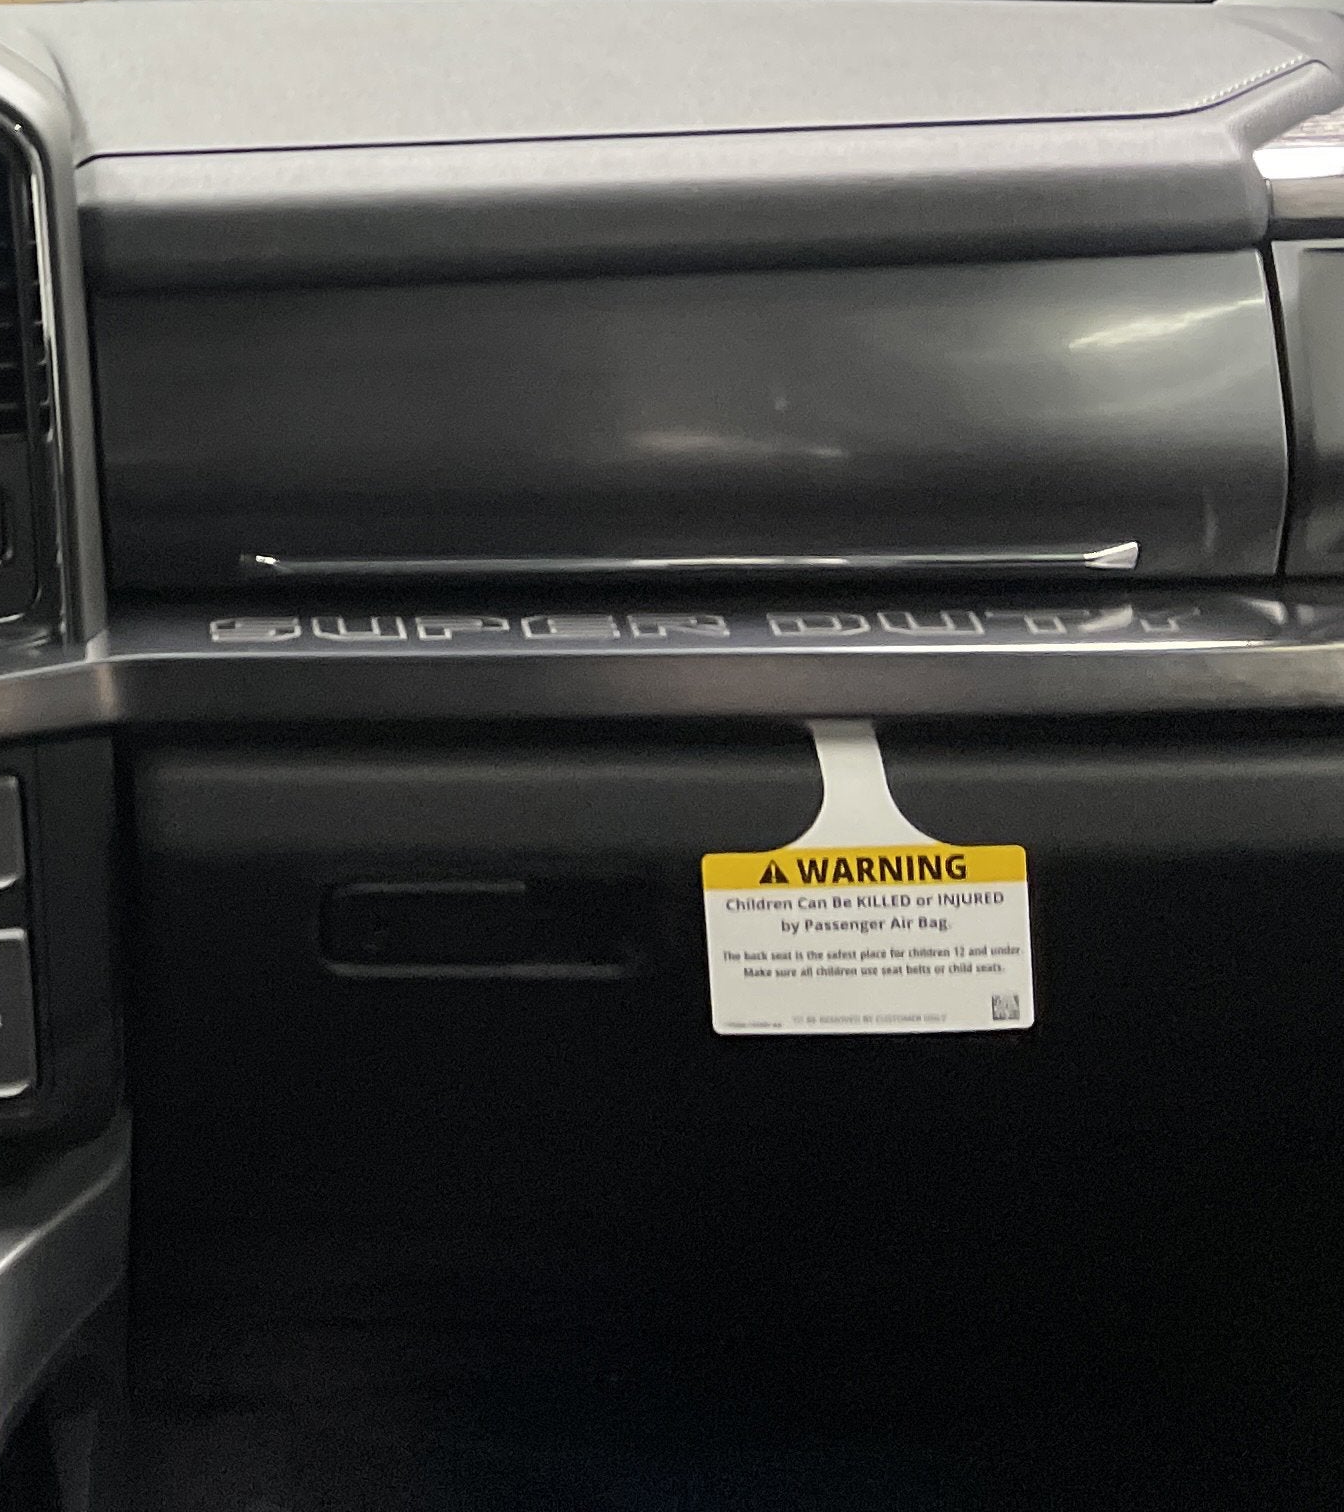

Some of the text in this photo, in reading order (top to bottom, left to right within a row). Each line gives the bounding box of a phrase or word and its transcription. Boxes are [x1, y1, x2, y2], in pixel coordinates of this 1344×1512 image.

[208, 602, 1202, 643] SUPER DUTY
[796, 853, 968, 884] WARNING
[725, 891, 1005, 911] Children Can Be KILLED or INJURED
[781, 919, 800, 935] by
[804, 918, 884, 934] Passenger
[890, 917, 914, 930] Air
[723, 950, 741, 962] The
[744, 950, 768, 961] back
[771, 950, 792, 961] seat
[795, 950, 804, 960] is
[806, 950, 824, 960] the
[826, 949, 857, 960] safest
[860, 948, 887, 962] place
[890, 947, 905, 959] for
[908, 946, 951, 958] children
[968, 945, 987, 956] and
[744, 967, 772, 978] Make
[775, 967, 797, 977] sure
[800, 966, 812, 977] all
[815, 965, 858, 977] children
[860, 966, 878, 976] use
[881, 965, 903, 976] seat
[906, 964, 931, 975] belts
[934, 964, 945, 974] or
[948, 963, 973, 974] child
